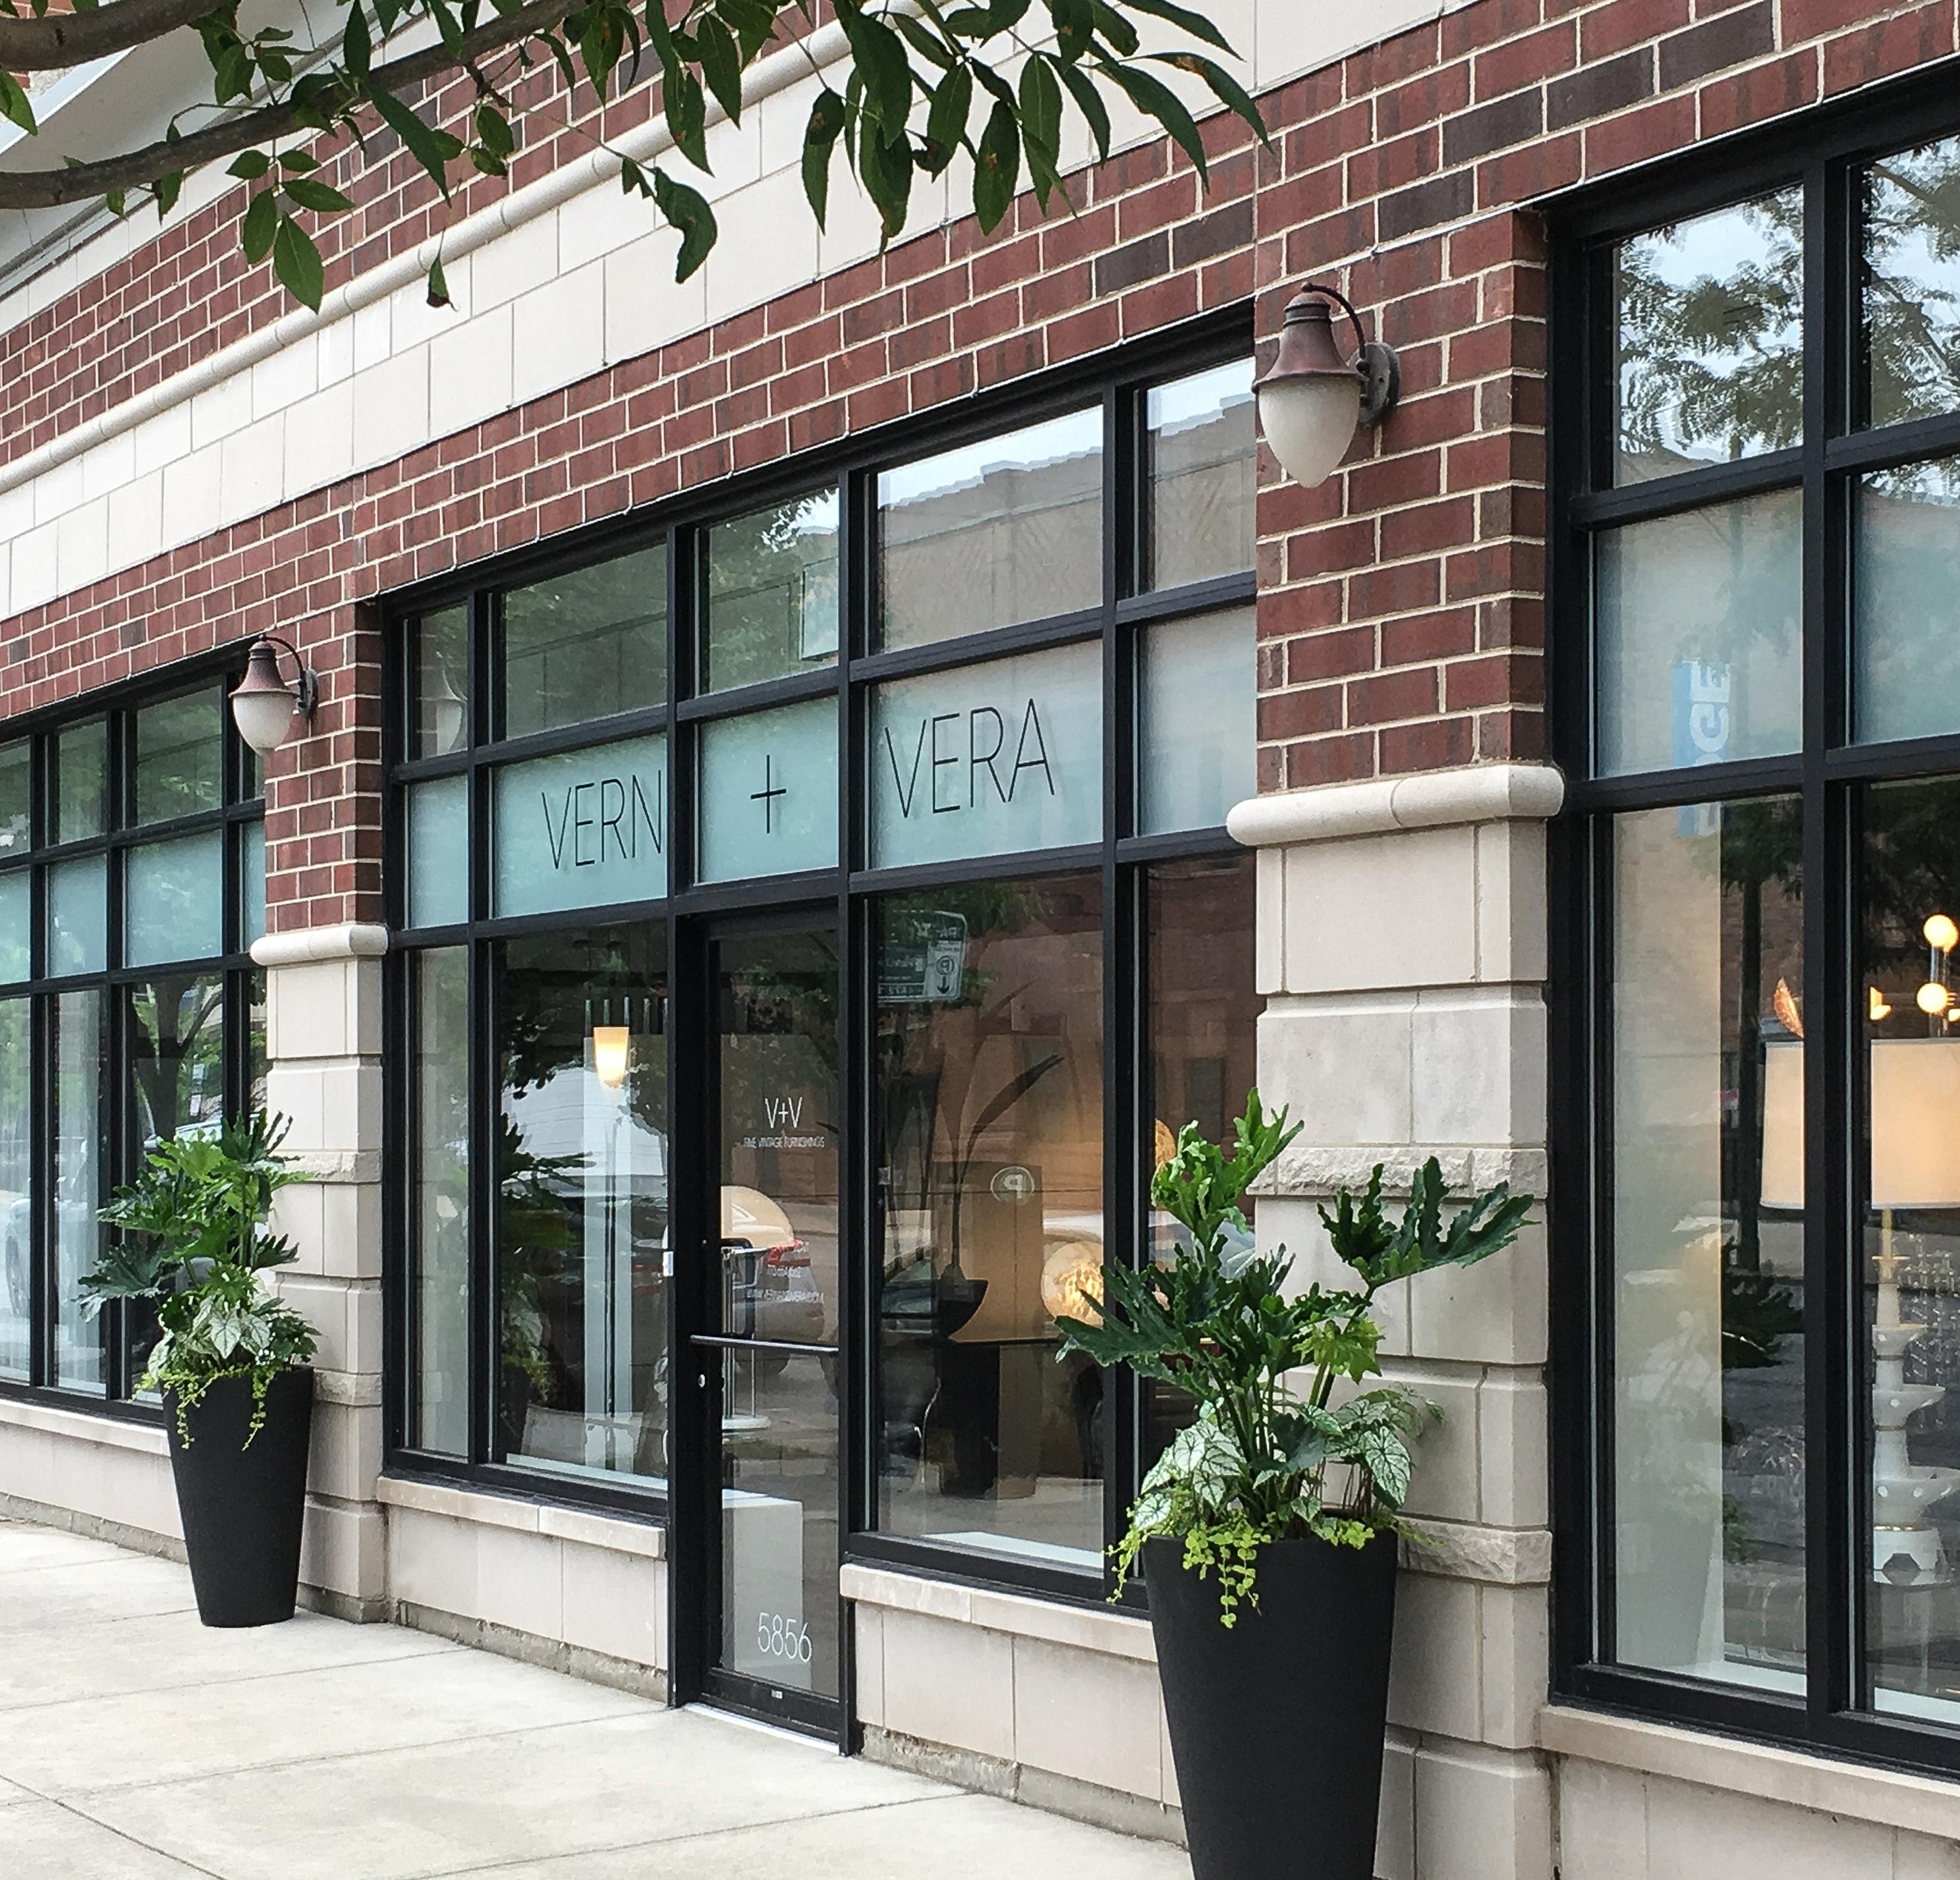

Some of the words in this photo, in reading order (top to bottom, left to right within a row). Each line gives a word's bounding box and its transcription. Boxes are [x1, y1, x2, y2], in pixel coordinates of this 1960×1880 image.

[542, 769, 662, 870] VERN
[750, 754, 787, 834] +
[884, 698, 1055, 819] VERA
[765, 1096, 803, 1129] V+V
[758, 1612, 812, 1663] 5856
